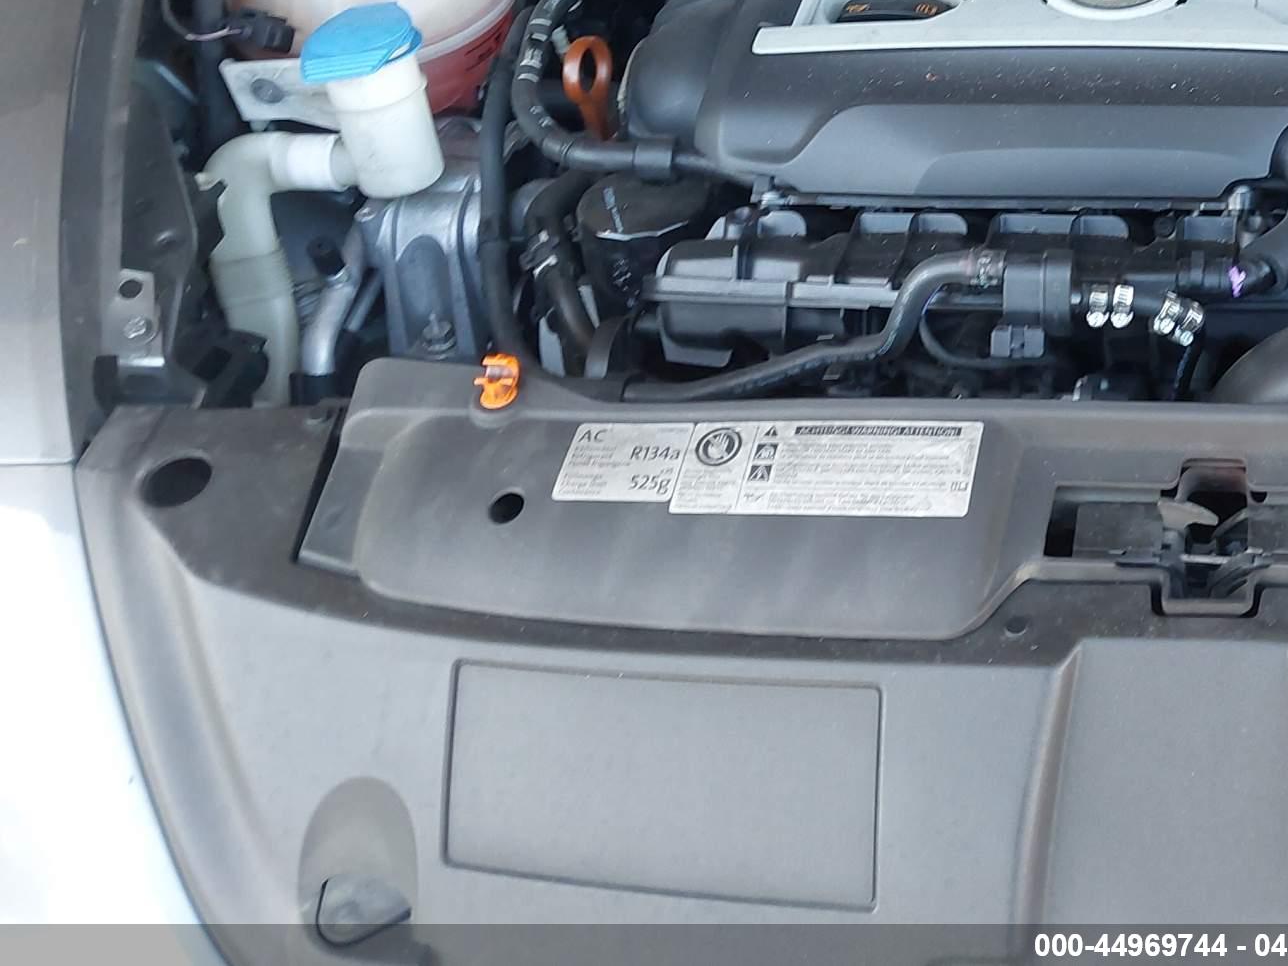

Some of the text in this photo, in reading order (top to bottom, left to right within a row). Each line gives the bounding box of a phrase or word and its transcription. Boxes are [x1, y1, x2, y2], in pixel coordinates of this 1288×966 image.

[578, 429, 608, 443] AC
[629, 445, 682, 462] R134a
[628, 474, 672, 495] 525g
